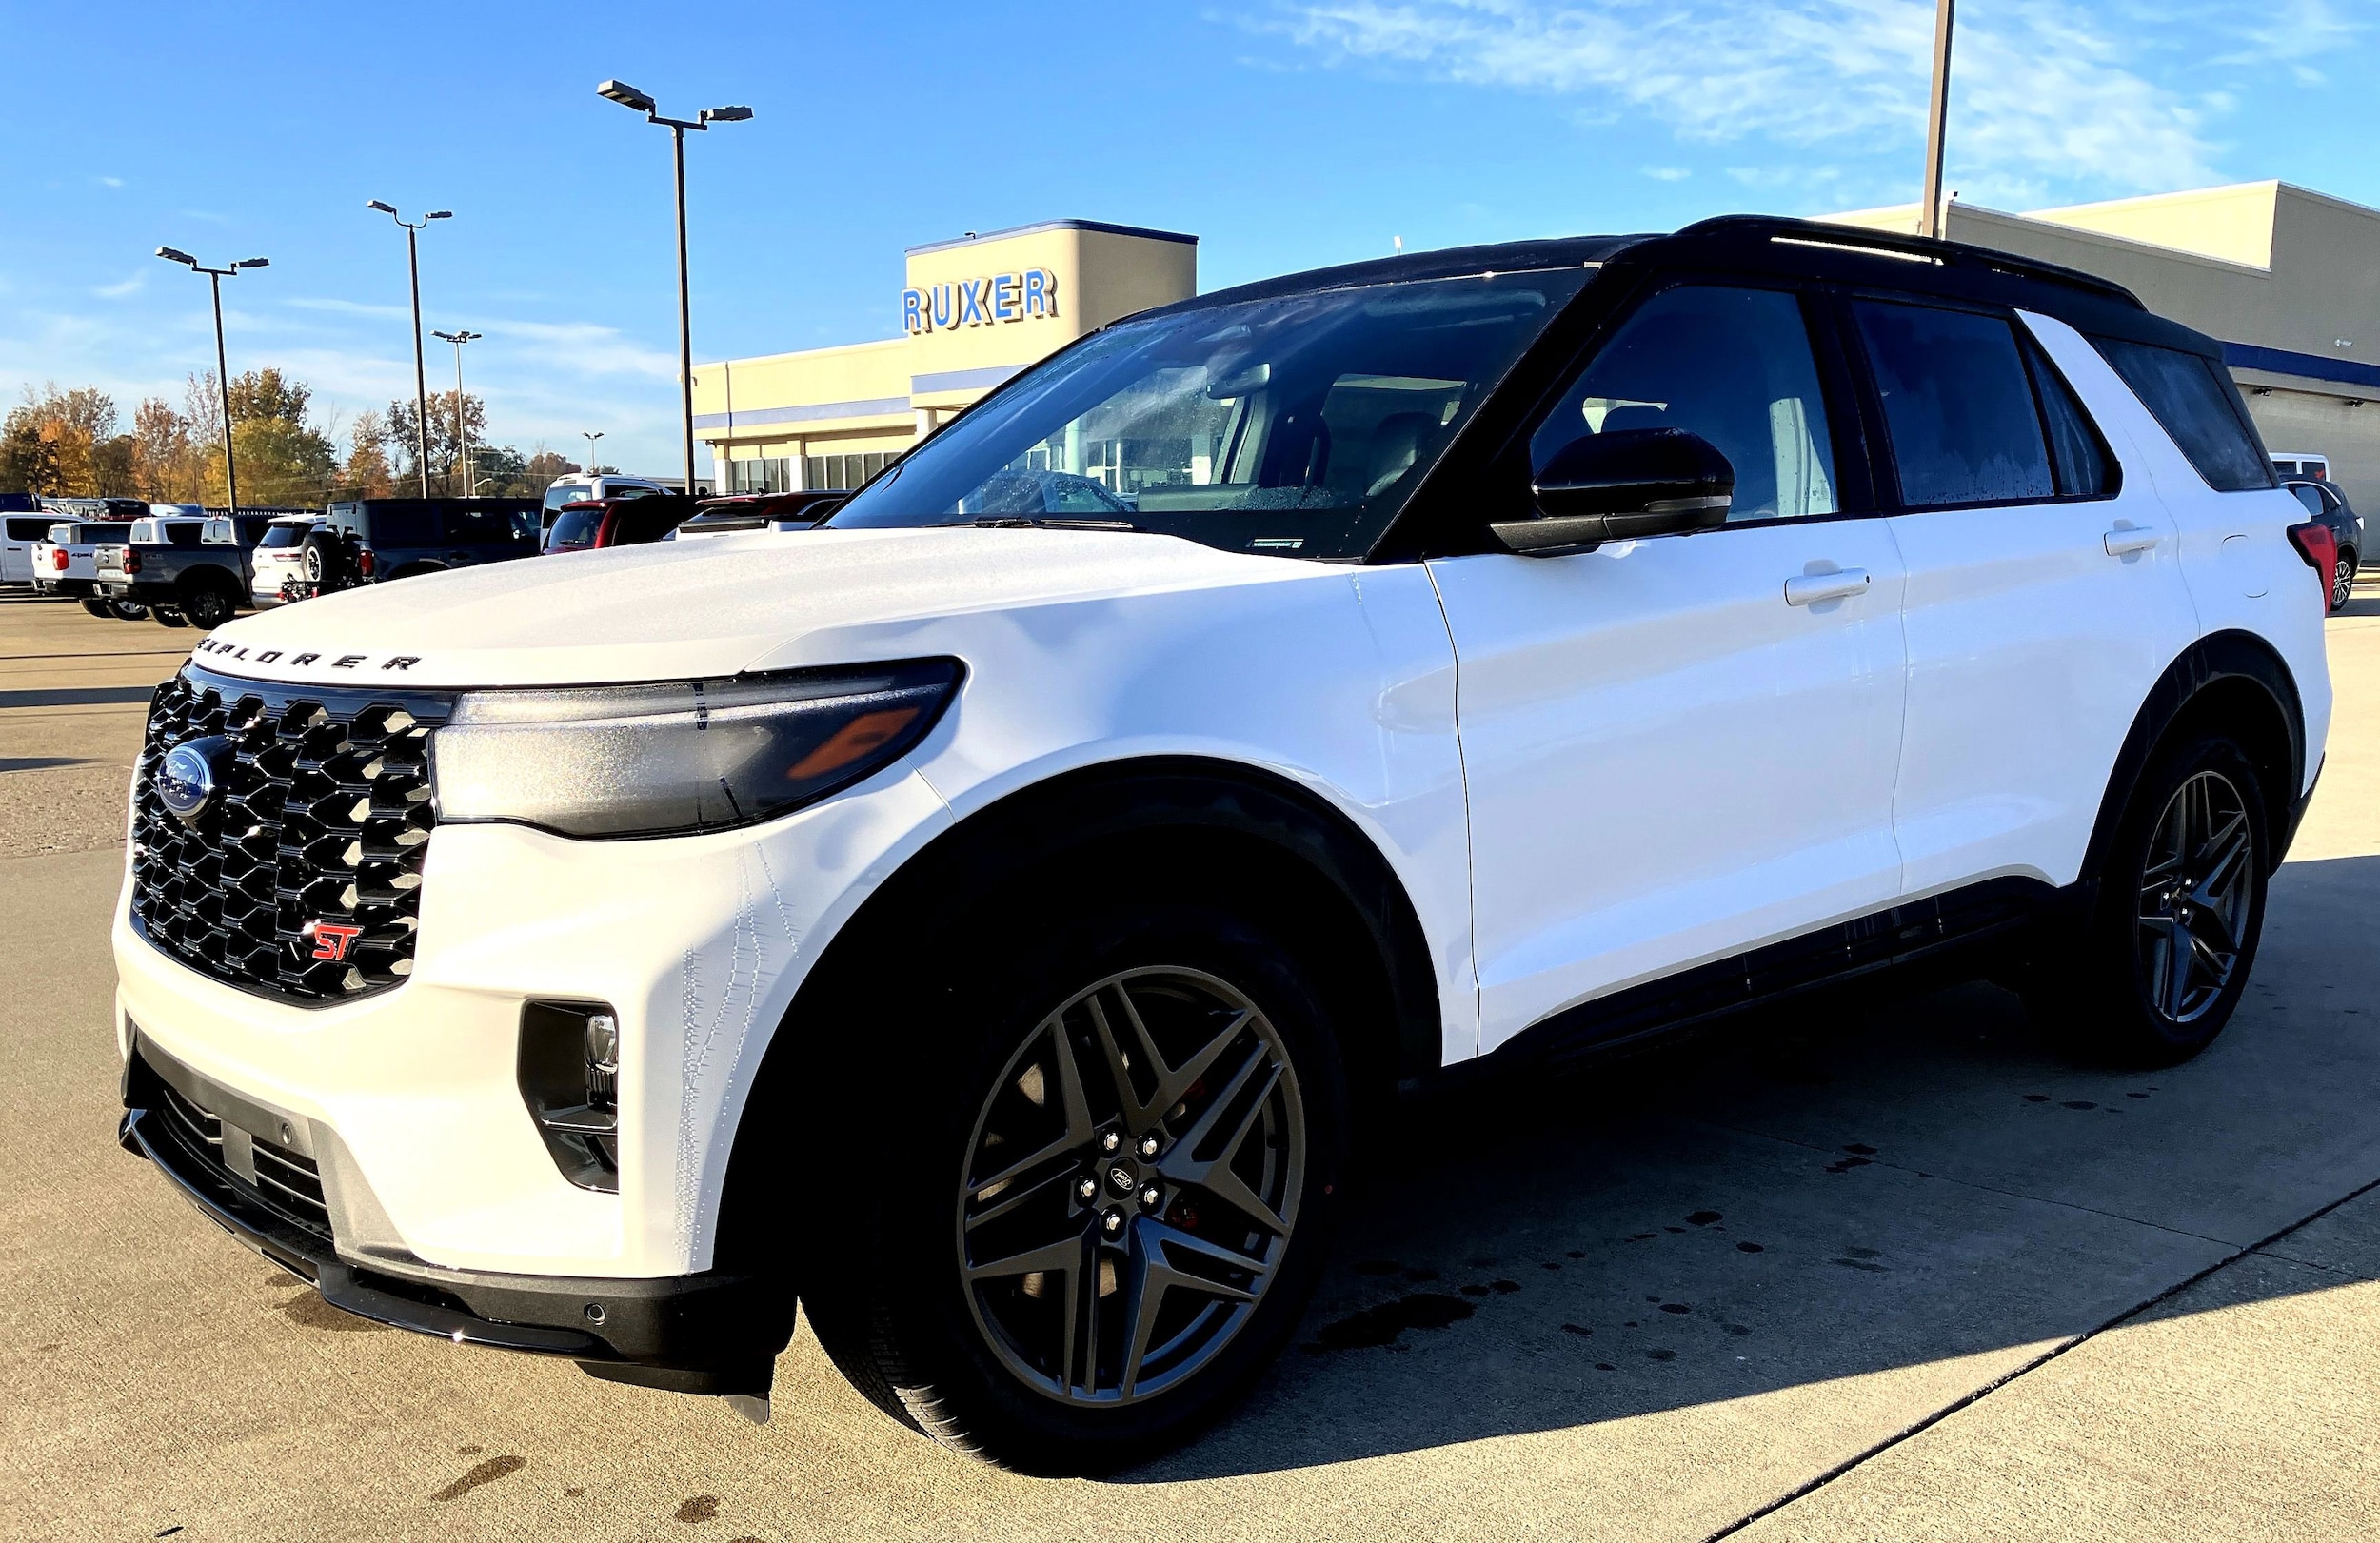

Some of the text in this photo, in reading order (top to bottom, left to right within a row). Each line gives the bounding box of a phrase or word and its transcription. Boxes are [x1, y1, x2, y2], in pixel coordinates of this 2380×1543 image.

[902, 268, 1059, 335] RUXER
[312, 923, 362, 961] ST
[1113, 1170, 1132, 1188] Ford
